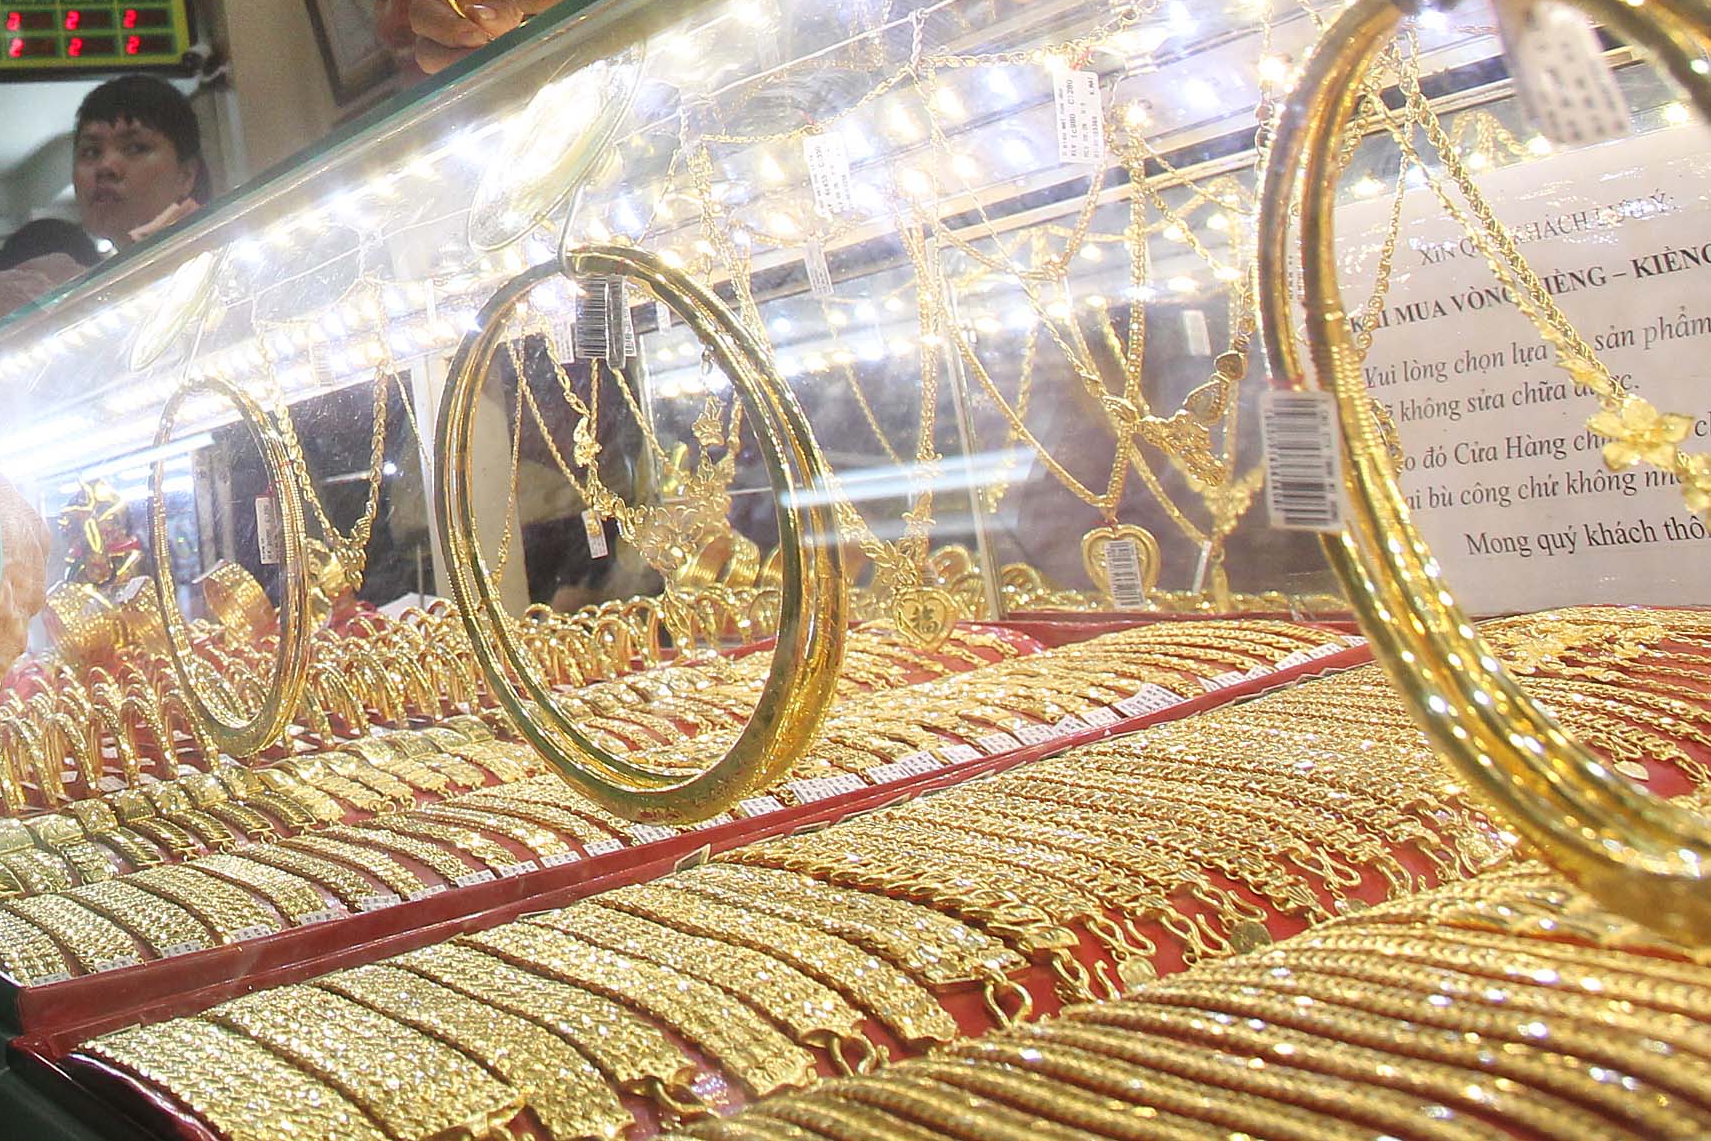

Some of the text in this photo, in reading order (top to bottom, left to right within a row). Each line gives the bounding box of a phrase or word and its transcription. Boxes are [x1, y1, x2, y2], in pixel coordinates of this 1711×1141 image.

[1350, 310, 1389, 333] KI
[1395, 300, 1448, 325] MUA
[1402, 359, 1448, 383] lòng
[1453, 349, 1504, 374] chọn
[1511, 342, 1548, 367] lựa
[1594, 325, 1635, 352] sản
[1642, 305, 1711, 351] phẩm
[1400, 397, 1462, 422] không
[1467, 388, 1505, 414] sửa
[1511, 380, 1567, 407] chữa
[1454, 441, 1498, 465] Cửa
[1506, 434, 1567, 460] Hàng
[1428, 485, 1453, 509] bù
[1460, 481, 1512, 508] công
[1517, 473, 1559, 501] chứ
[1566, 469, 1637, 496] không
[1465, 515, 1711, 558] Mong quý khách thô
